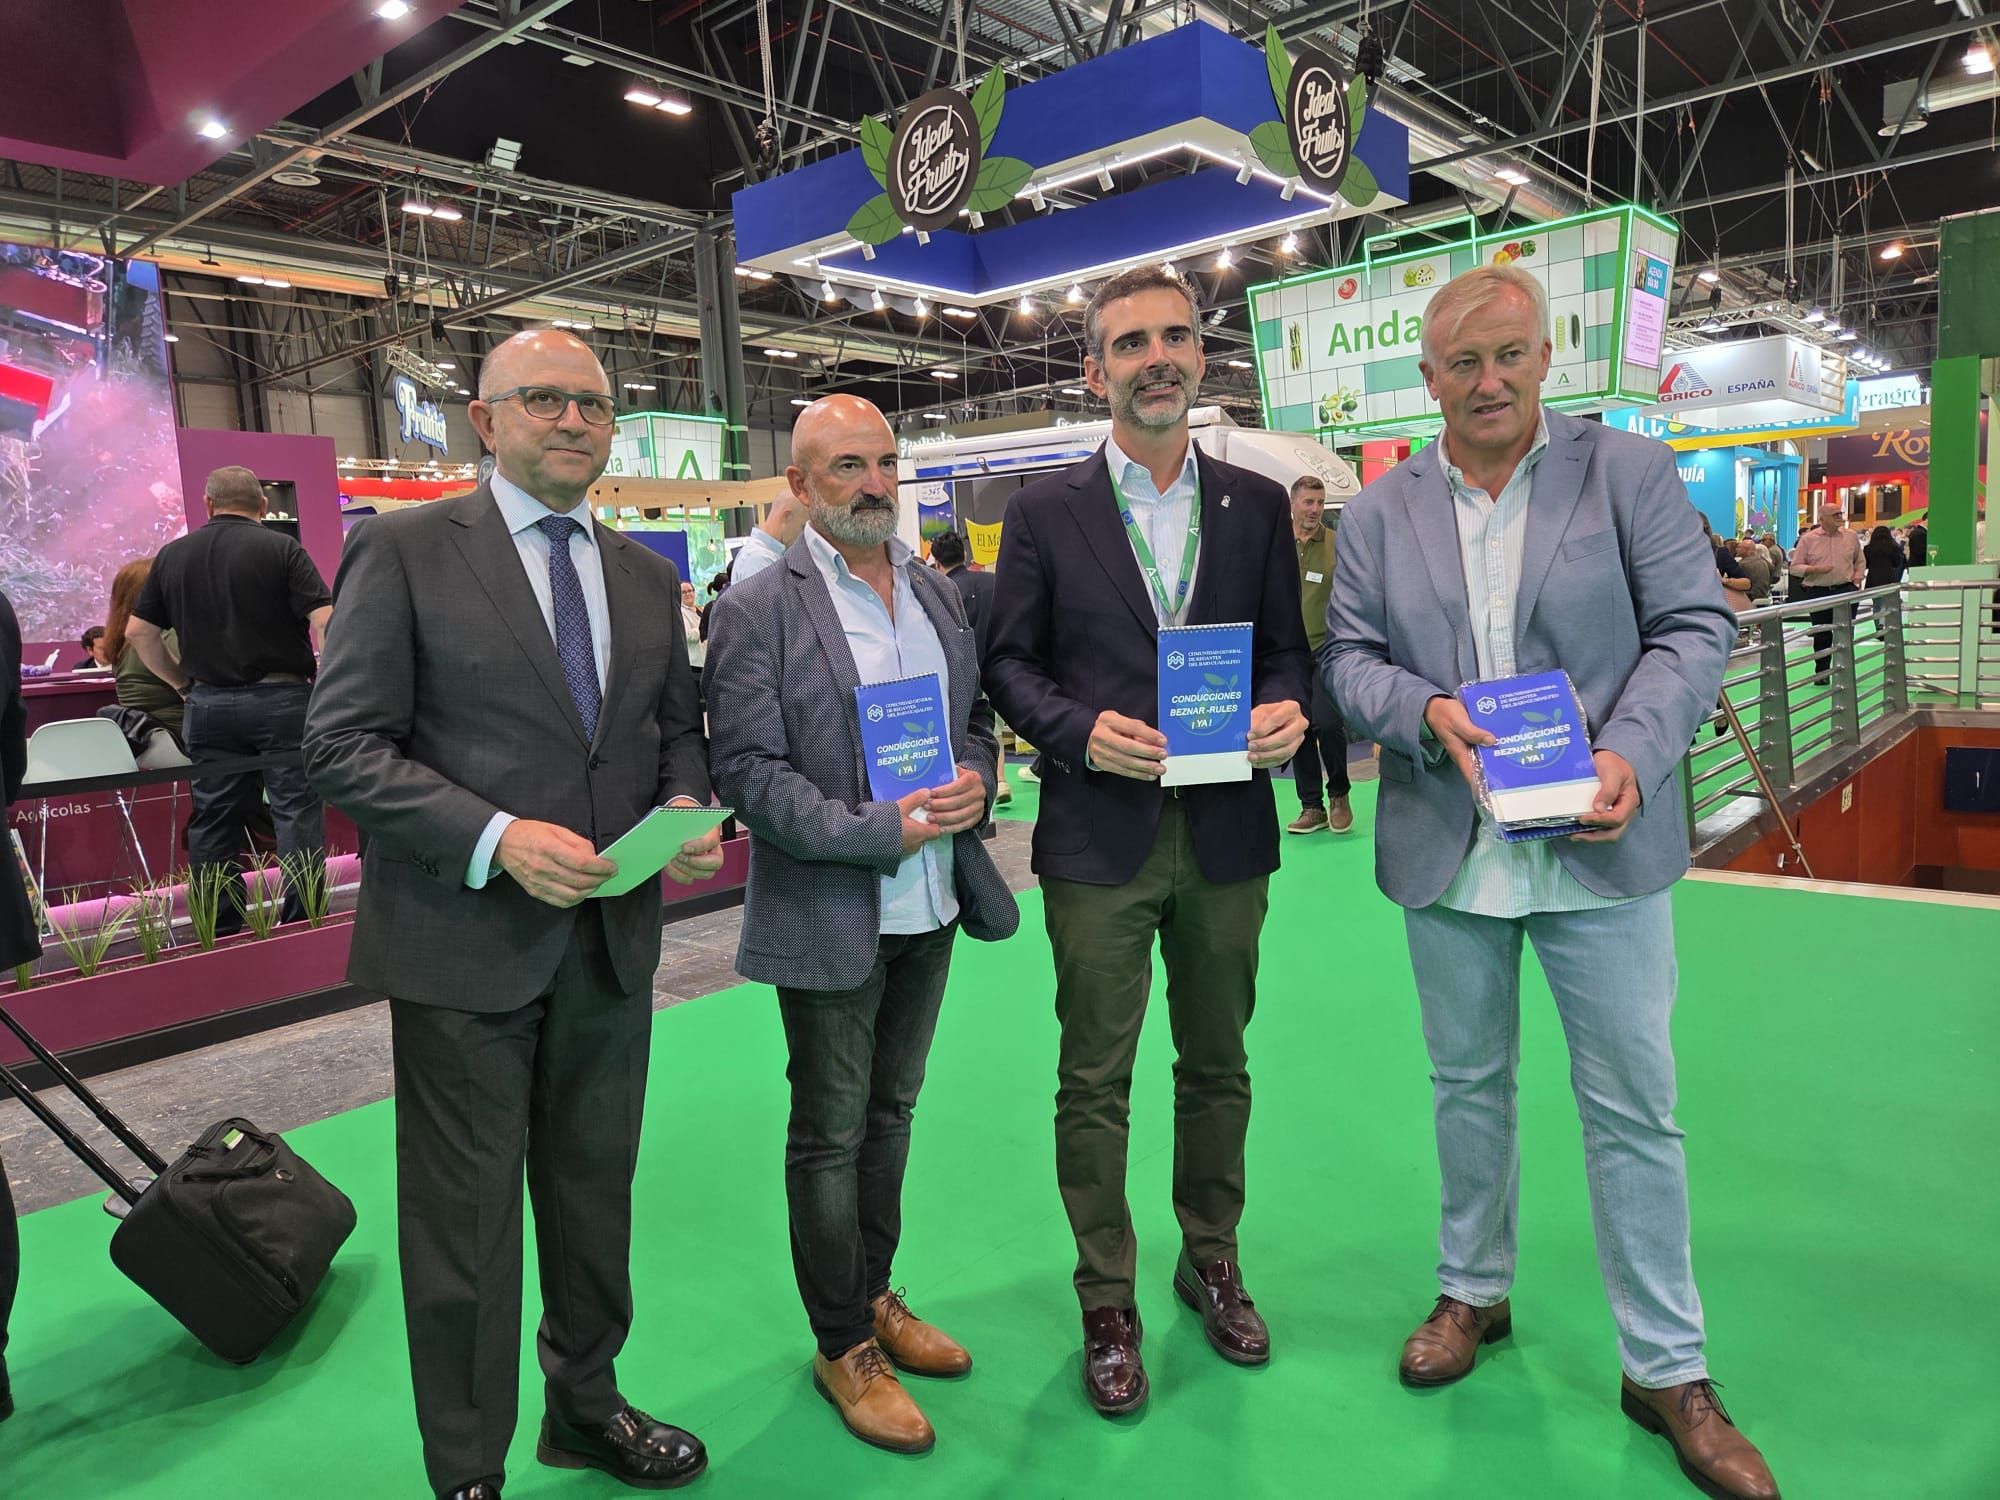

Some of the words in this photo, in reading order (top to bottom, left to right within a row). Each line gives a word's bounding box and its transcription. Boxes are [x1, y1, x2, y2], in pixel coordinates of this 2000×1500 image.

[1303, 79, 1337, 121] Ideal
[908, 104, 954, 171] Ideal
[1300, 118, 1345, 161] Fruits
[904, 143, 970, 212] Fruits
[1328, 310, 1423, 357] Anda
[1660, 388, 1713, 403] GRICO
[1727, 379, 1776, 394] ESPAÑA
[987, 533, 1001, 548] Ma
[1171, 691, 1242, 703] CONDUCCIONES
[1170, 707, 1204, 716] BEZNAR
[876, 736, 940, 754] CONDUCCIONES
[1495, 724, 1570, 745] CONDUCCIONES
[877, 754, 909, 766] BEZNAR
[1494, 745, 1532, 757] BEZNAR
